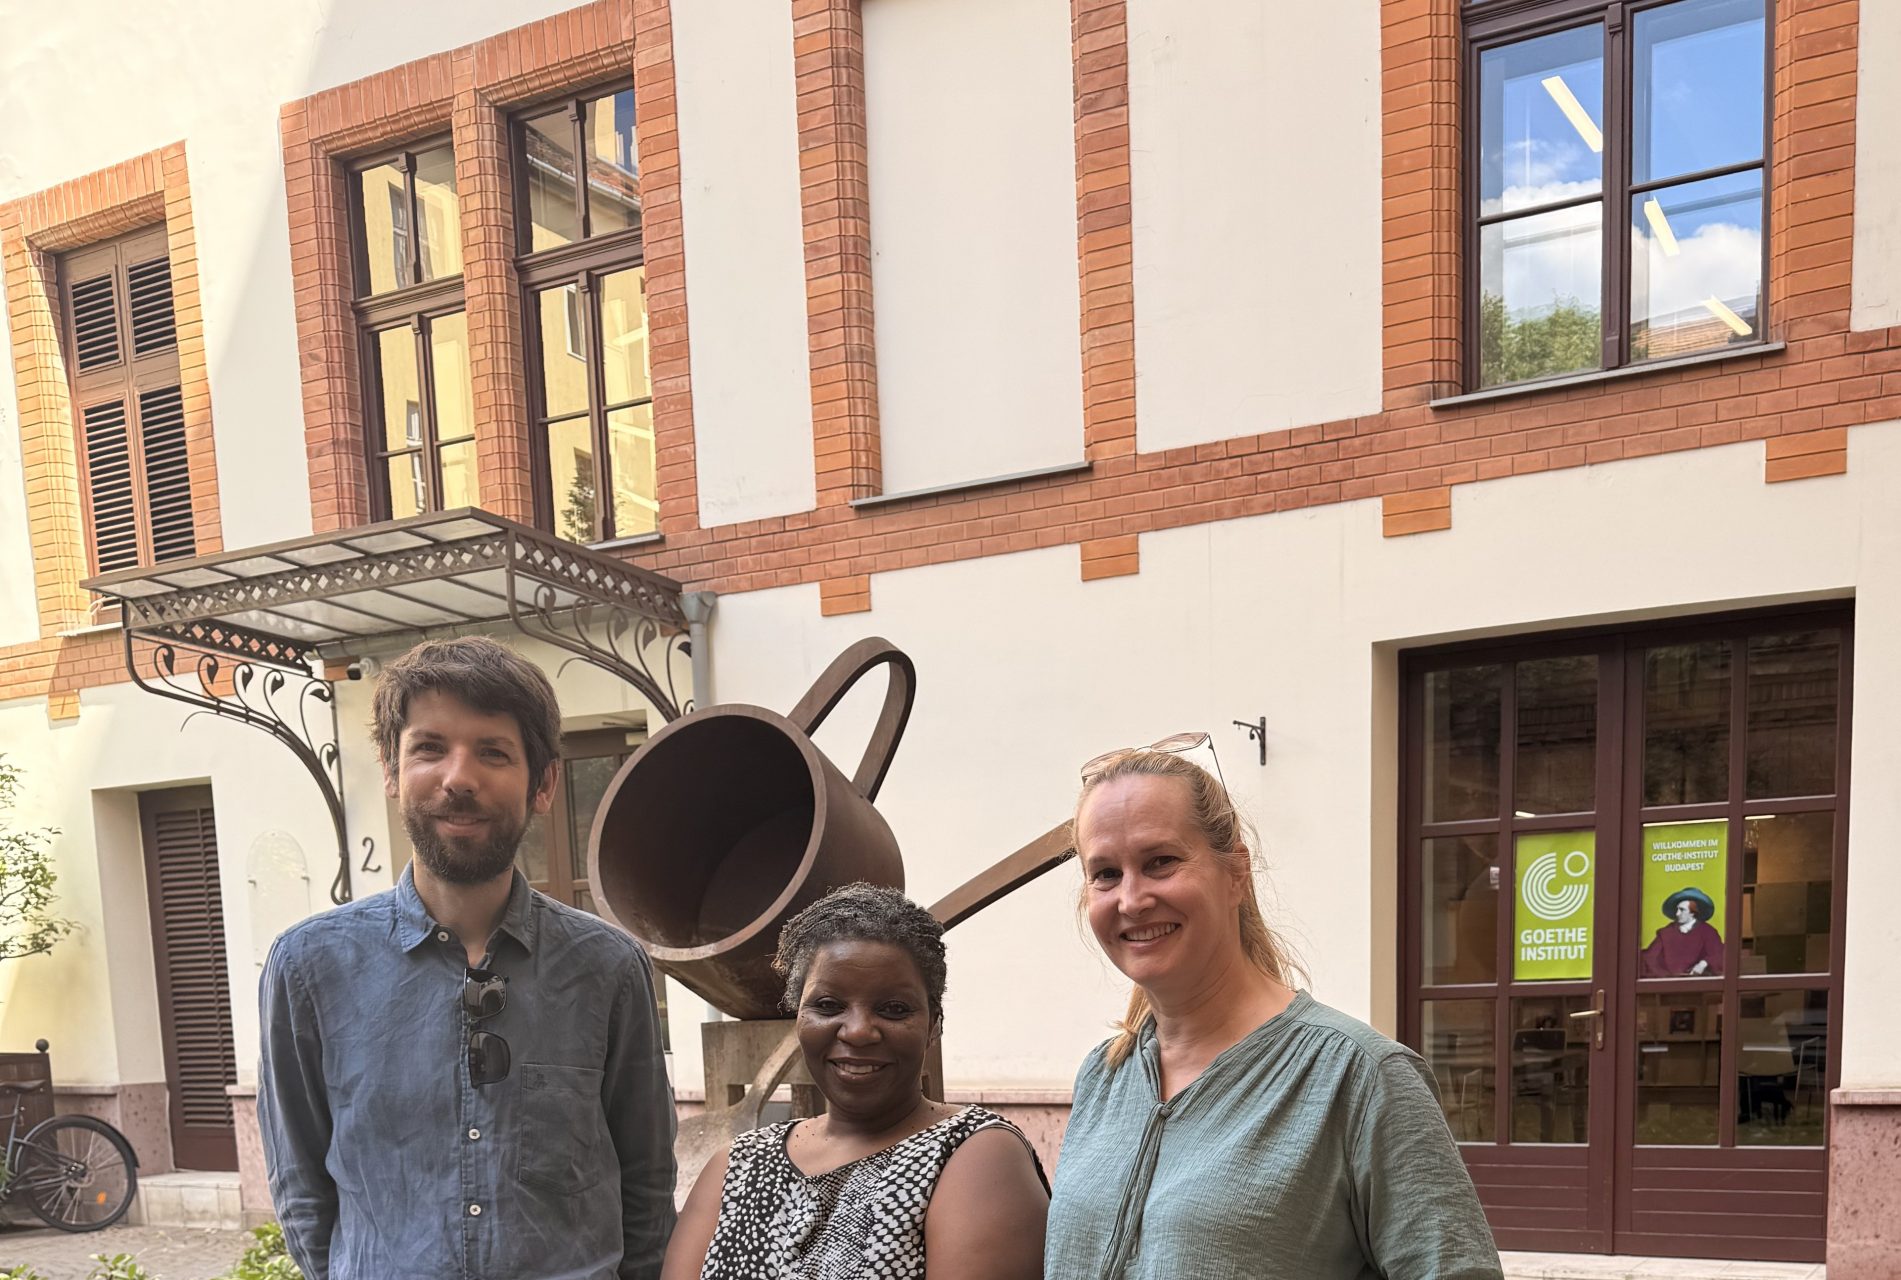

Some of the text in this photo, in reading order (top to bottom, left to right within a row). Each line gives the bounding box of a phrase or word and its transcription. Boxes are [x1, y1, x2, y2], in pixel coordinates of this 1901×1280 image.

[1652, 839, 1718, 850] WILLKOMMEN IM
[361, 836, 382, 873] 2
[1652, 850, 1718, 861] GOETHE-INSTITUT
[1664, 862, 1704, 872] BUDAPEST
[1520, 927, 1587, 944] GOETHE
[1520, 945, 1587, 961] INSTITUT
